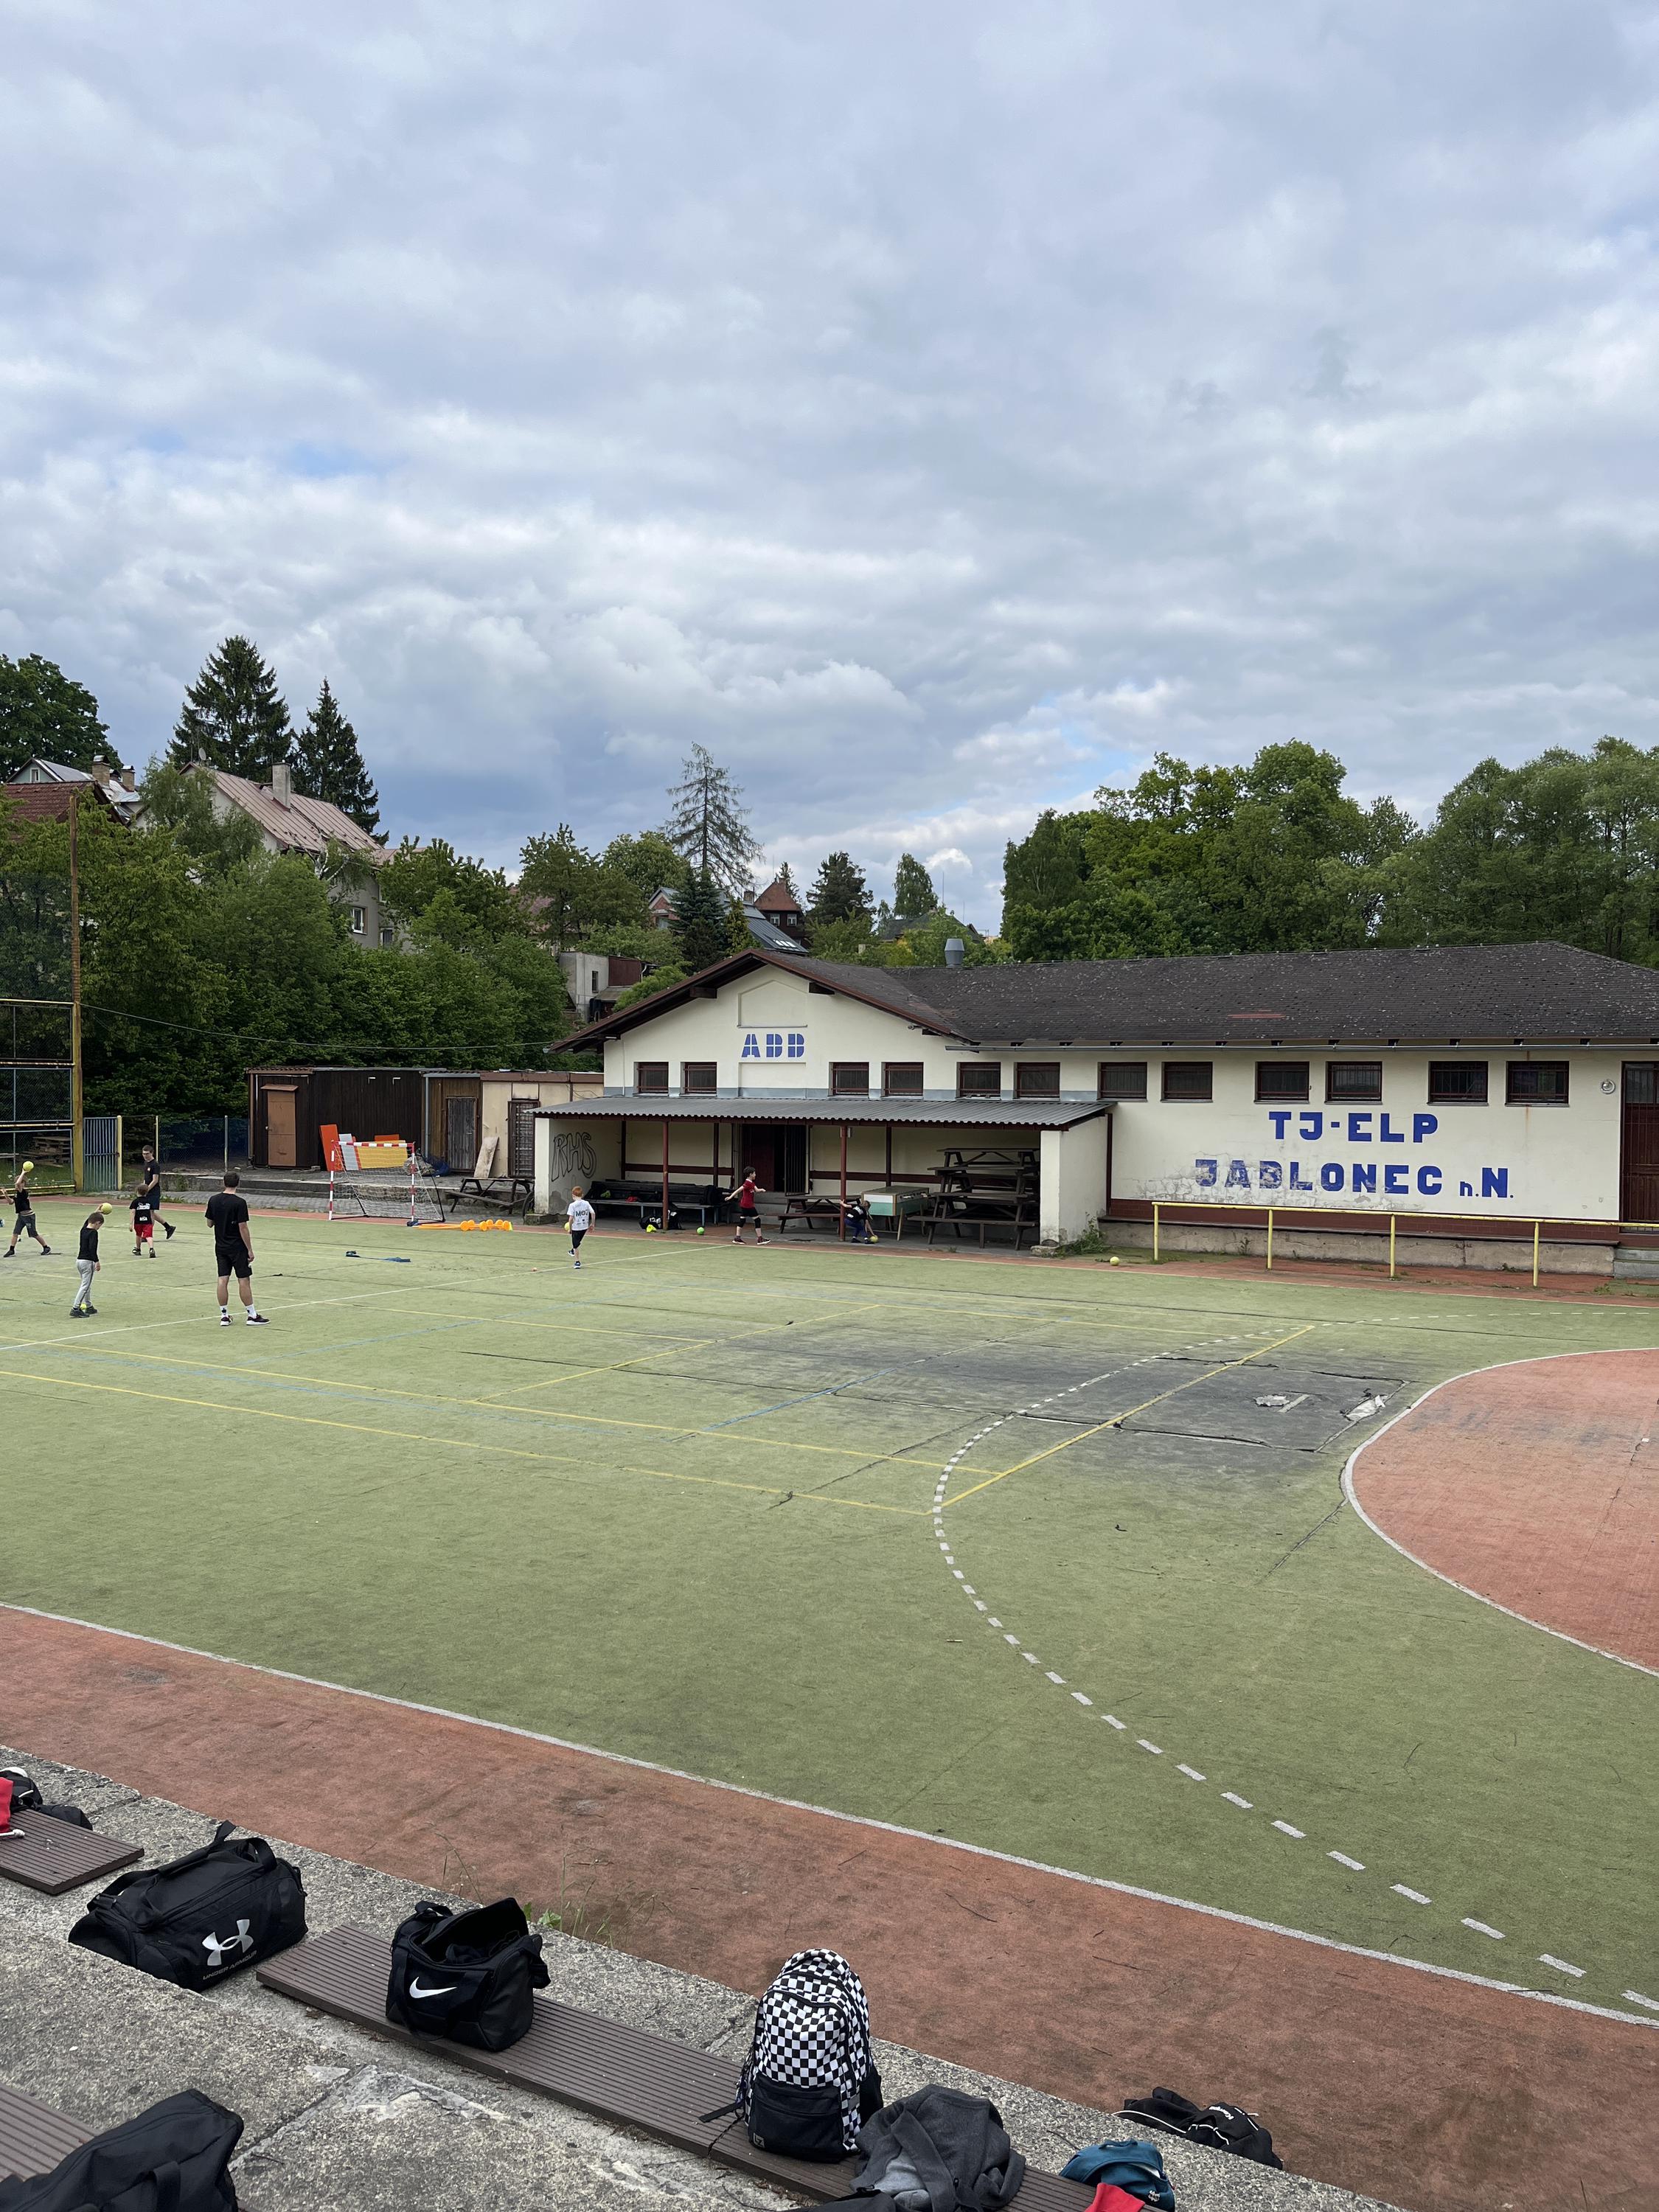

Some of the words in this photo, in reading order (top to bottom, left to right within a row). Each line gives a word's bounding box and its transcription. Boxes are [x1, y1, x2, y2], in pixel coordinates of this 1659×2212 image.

[741, 1033, 804, 1057] ABB
[1268, 1111, 1439, 1143] TJ-ELP
[1194, 1158, 1442, 1195] JABLONEC
[203, 1966, 229, 1980] UNDER
[229, 1950, 257, 1969] ARMOUR
